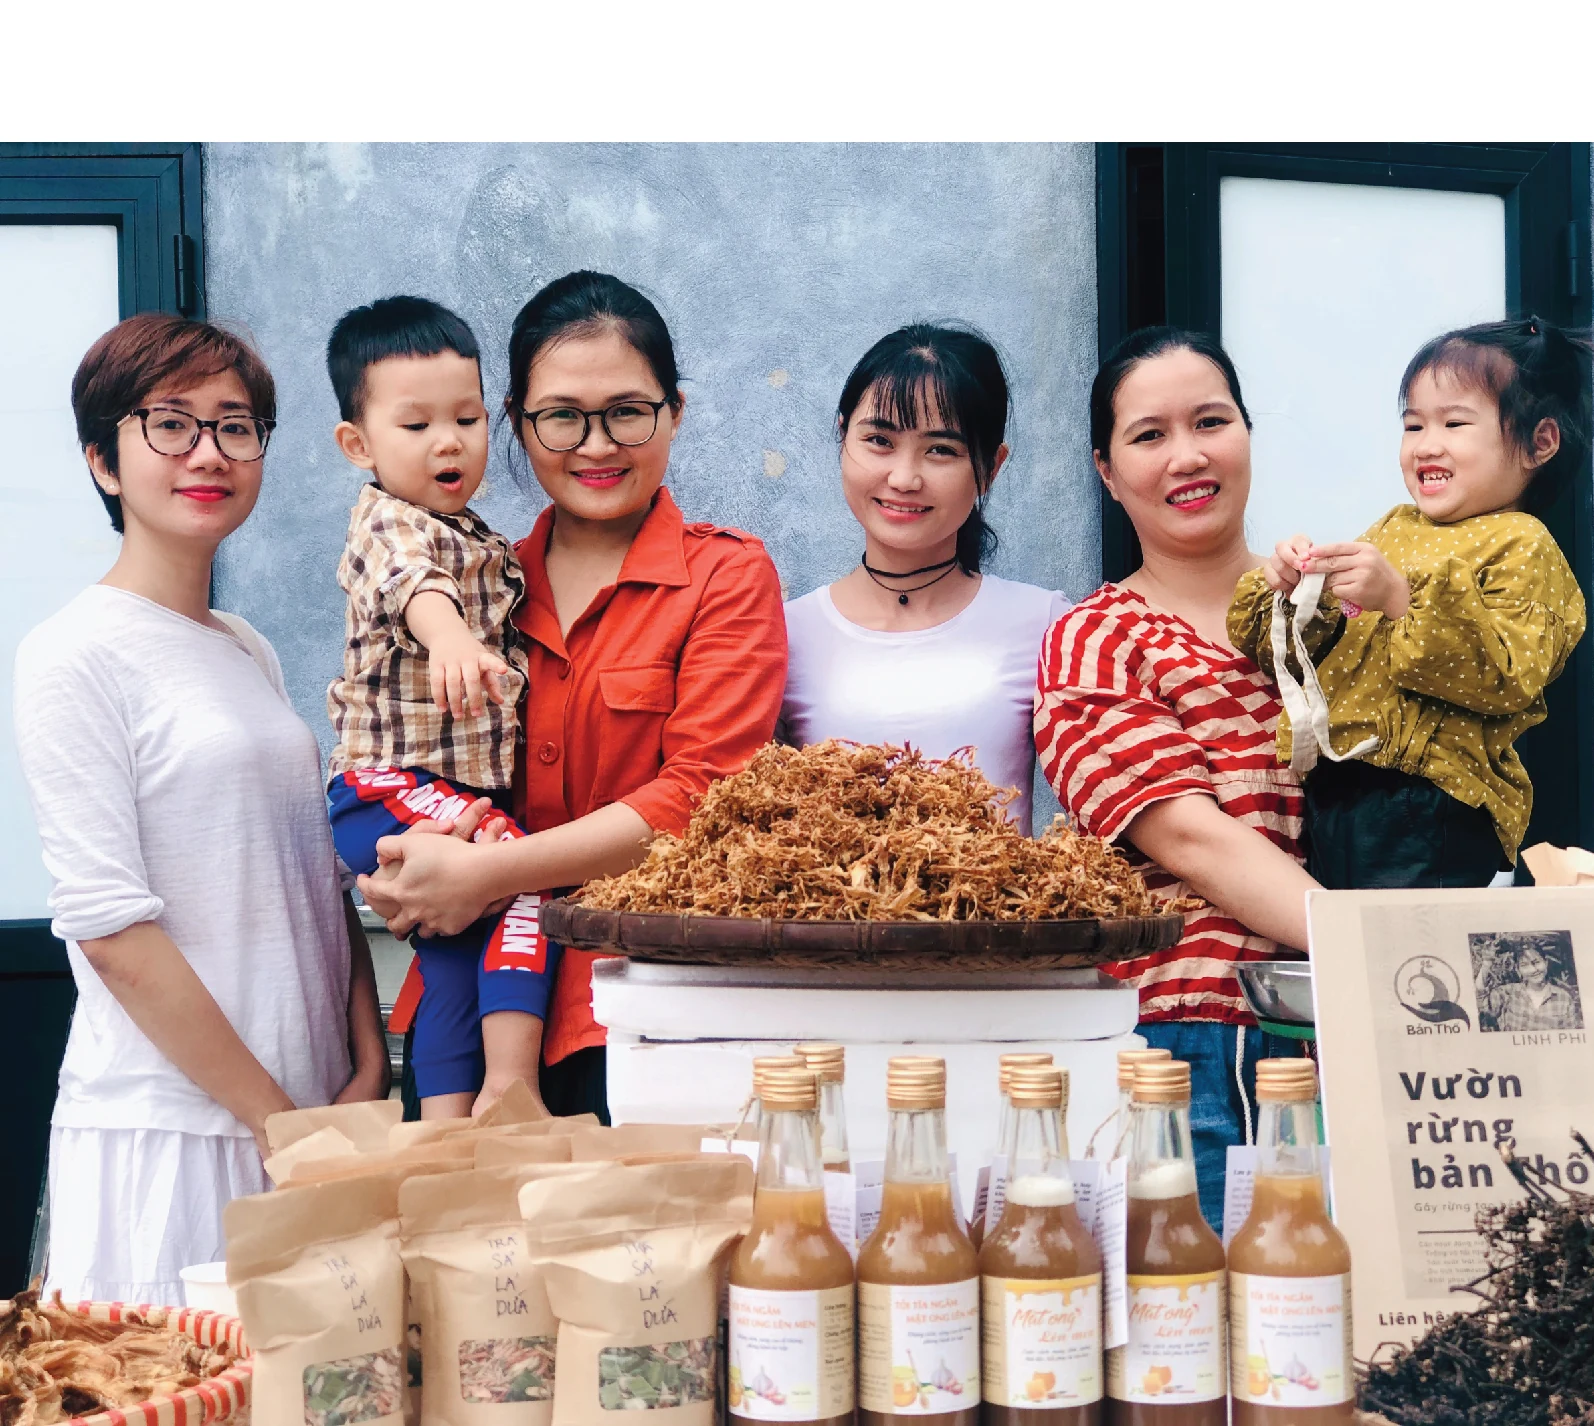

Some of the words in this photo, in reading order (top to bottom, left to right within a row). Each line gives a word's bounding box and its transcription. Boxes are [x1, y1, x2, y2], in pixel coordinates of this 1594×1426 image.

[1558, 1032, 1587, 1045] PHI
[1398, 1067, 1523, 1101] Vườn
[1406, 1111, 1517, 1151] rừng
[1411, 1153, 1494, 1190] bản
[1378, 1311, 1418, 1326] Liên
